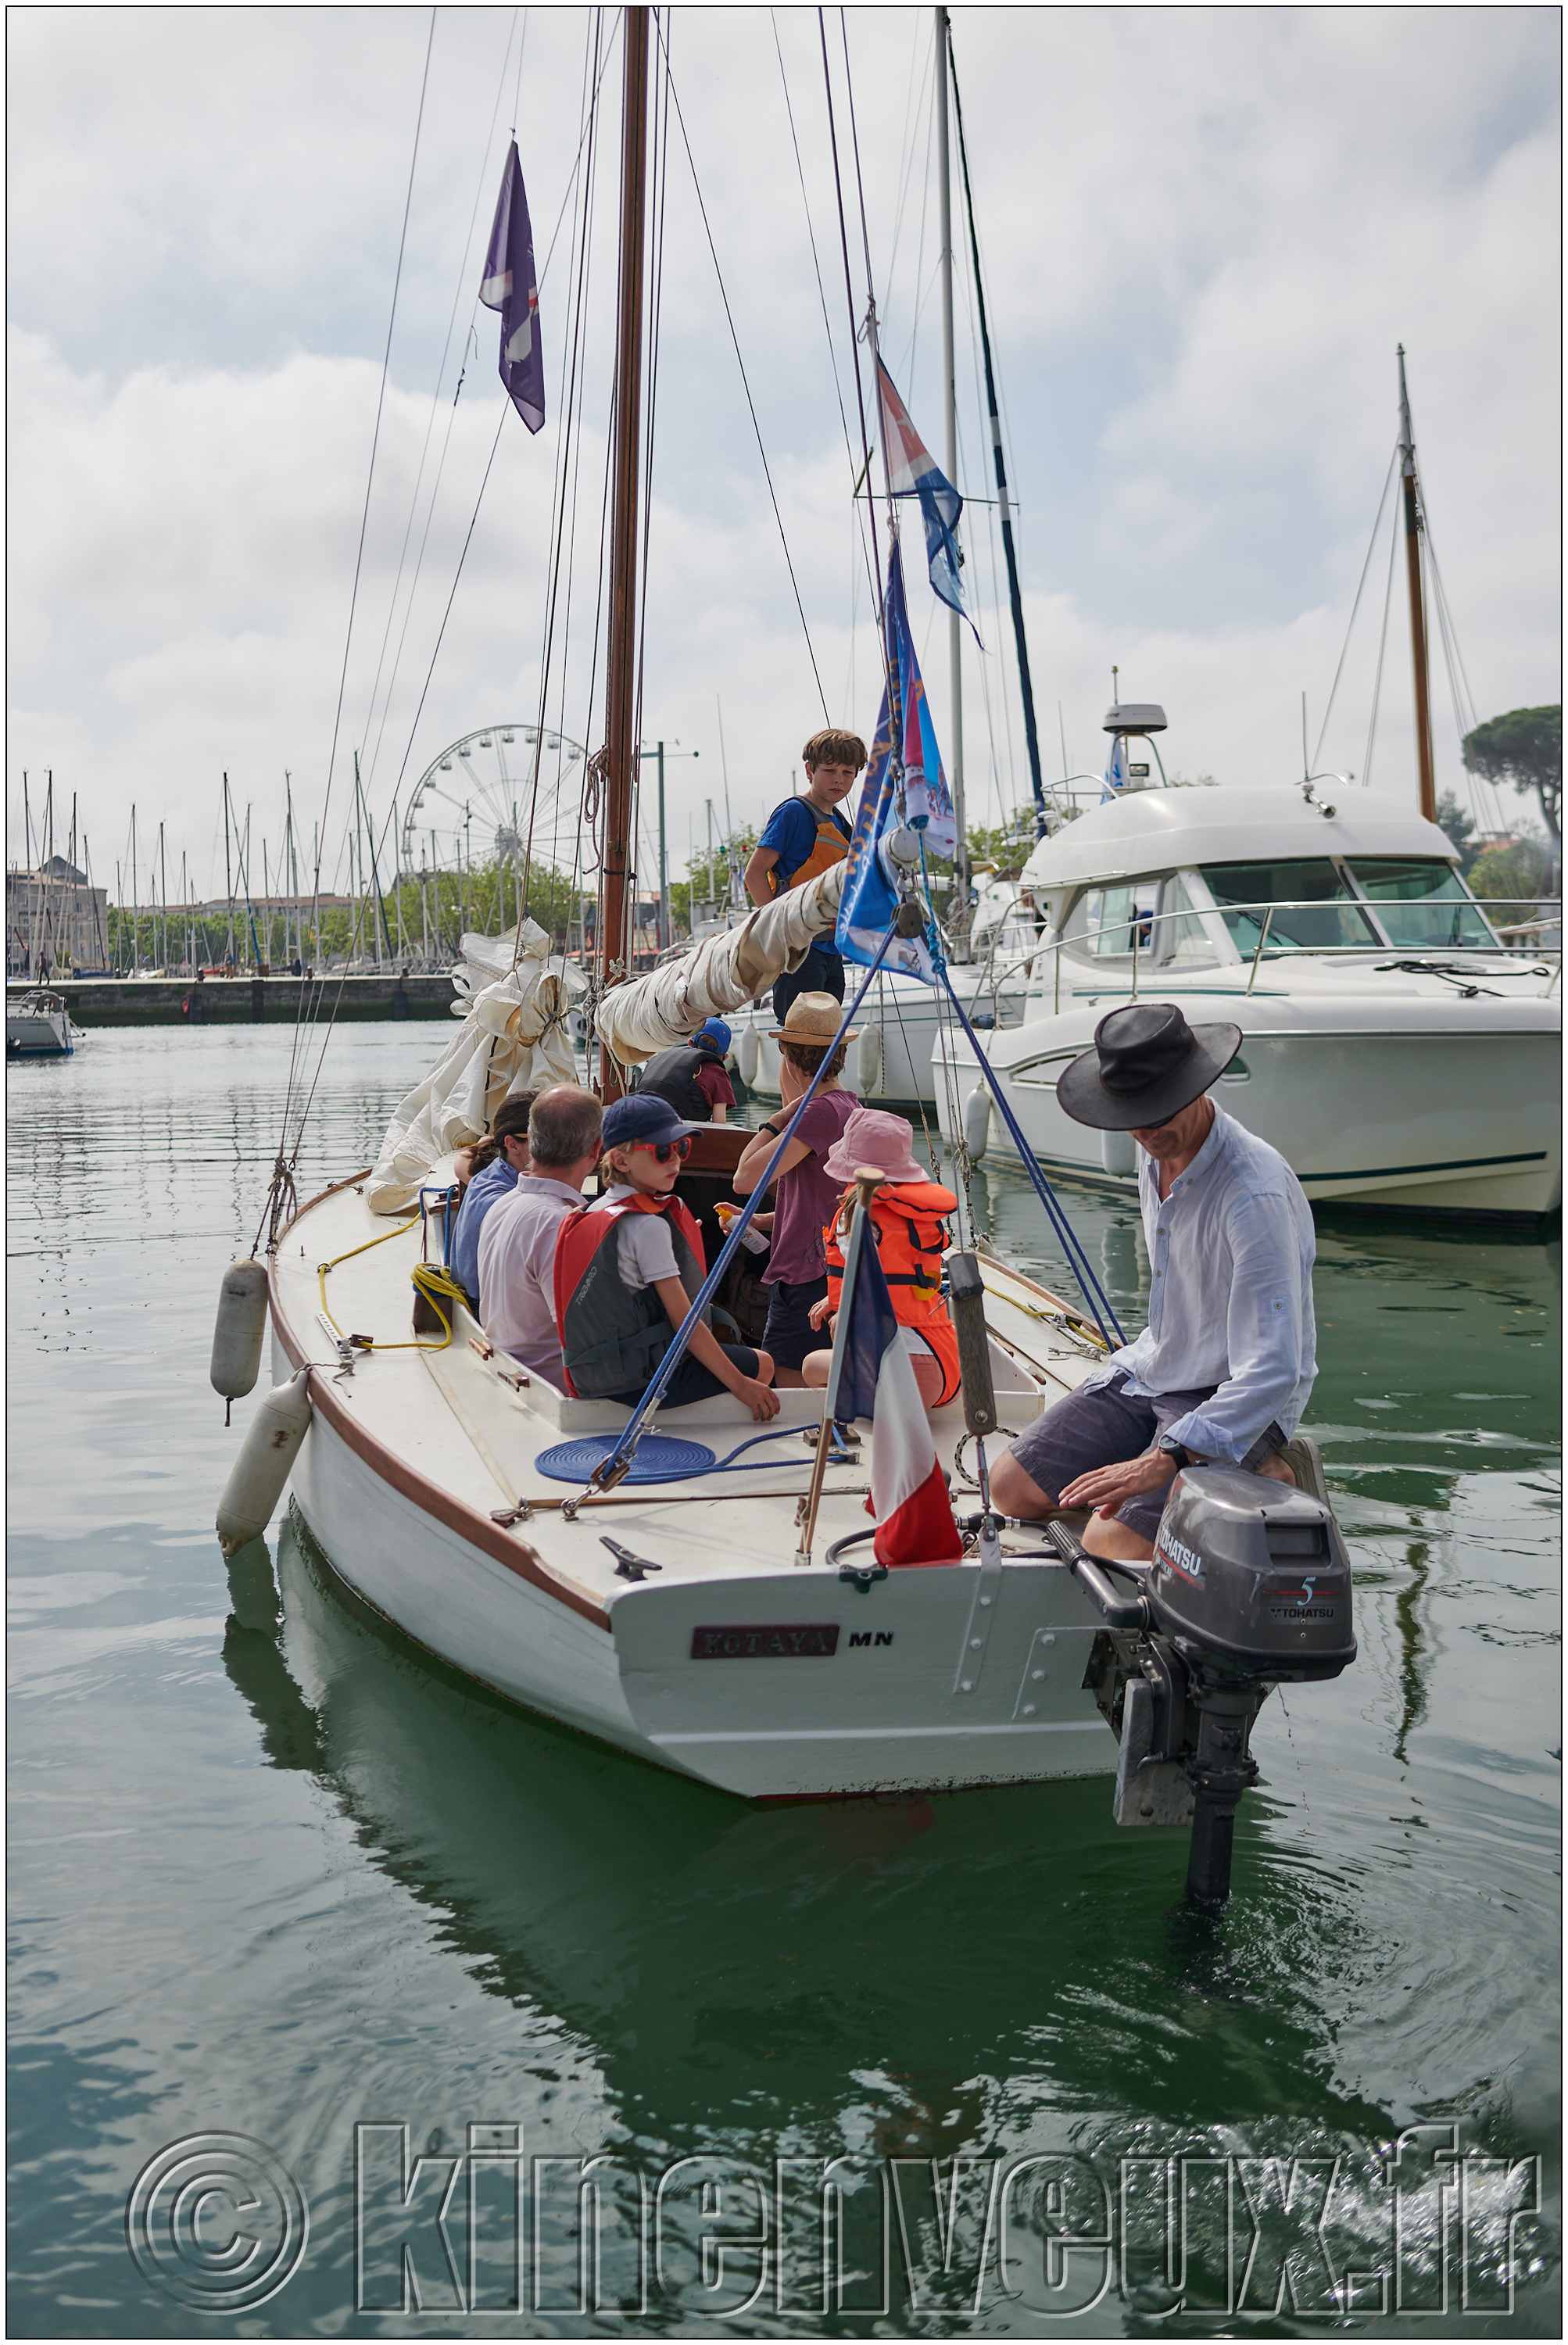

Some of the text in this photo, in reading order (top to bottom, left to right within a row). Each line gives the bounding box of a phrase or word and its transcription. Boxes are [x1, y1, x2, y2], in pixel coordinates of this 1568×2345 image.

[1159, 1525, 1201, 1576] TOHATSU
[1296, 1576, 1316, 1606] 5
[1283, 1608, 1334, 1618] TOHATSU
[704, 1631, 894, 1654] KOTAYA MN
